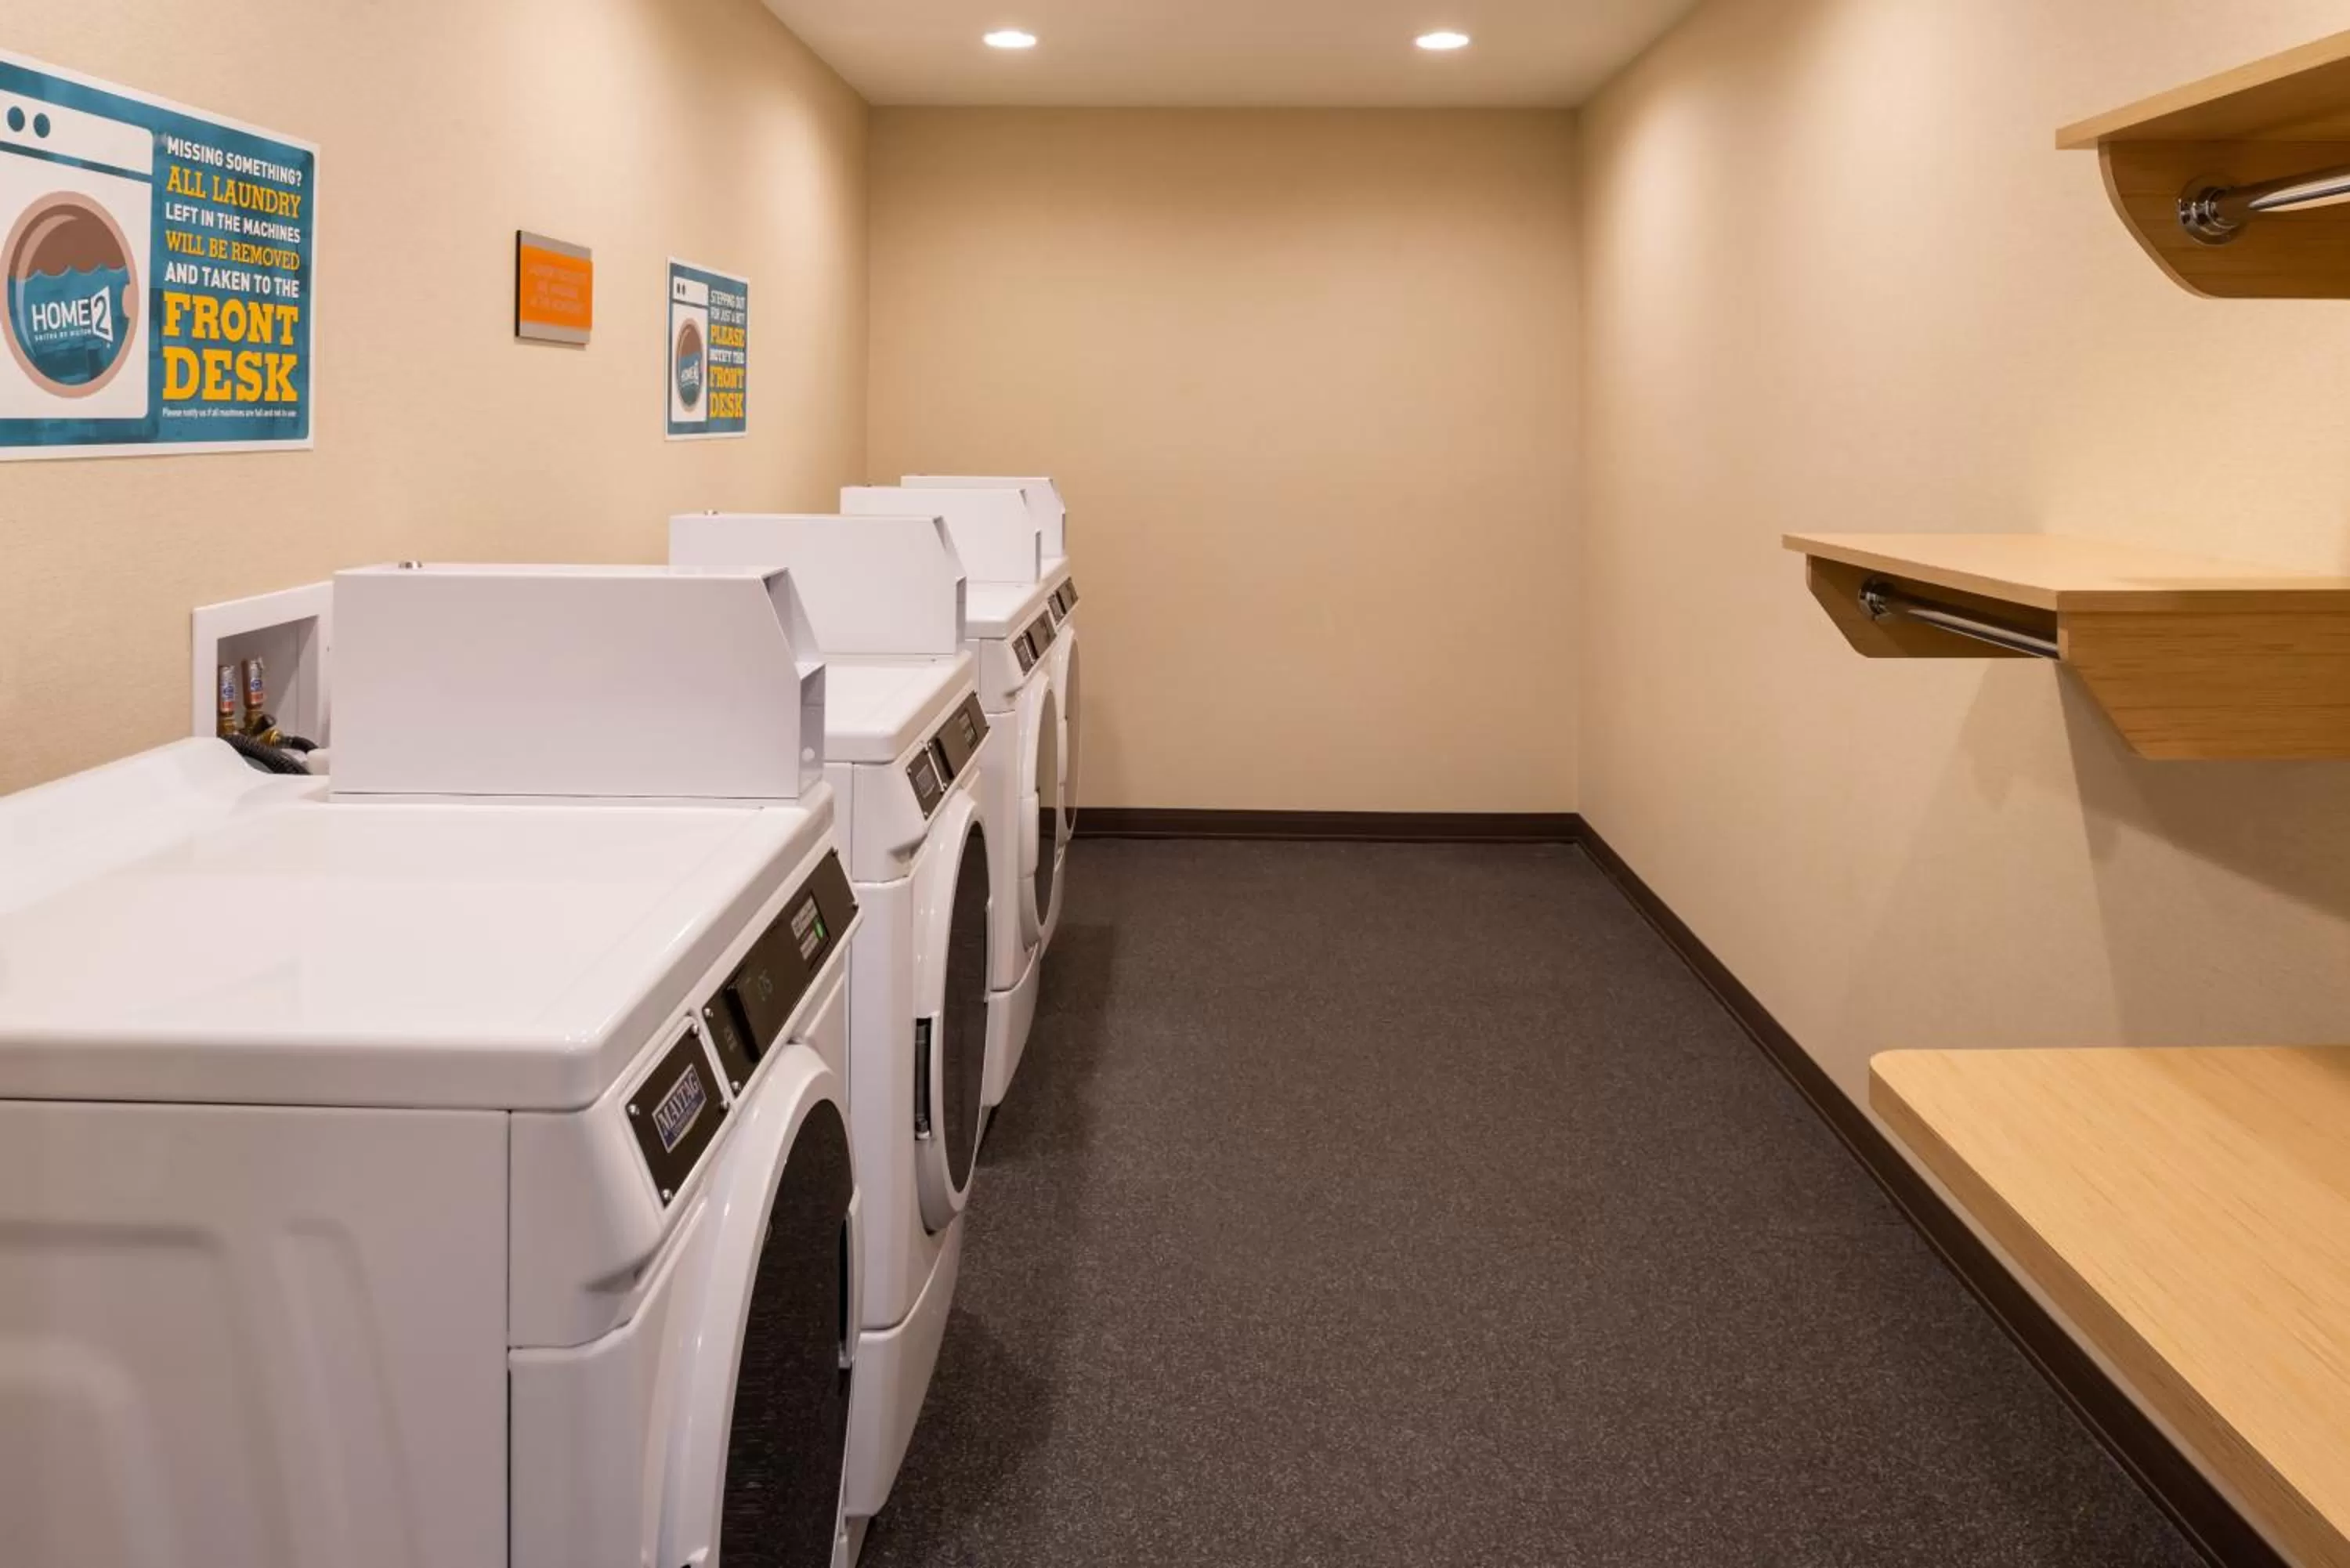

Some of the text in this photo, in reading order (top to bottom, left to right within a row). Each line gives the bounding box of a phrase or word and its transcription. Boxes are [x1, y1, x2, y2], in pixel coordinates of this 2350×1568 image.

[167, 135, 302, 187] MISSING SOMETHING?
[166, 165, 302, 219] ALL LAUNDRY
[165, 202, 301, 244] LEFT IN THE MACHINES
[165, 229, 300, 270] WILL BE REMOVED
[164, 261, 300, 298] AND TAKEN TO THE
[163, 291, 299, 345] FRONT
[710, 325, 745, 349] PLEASE
[162, 345, 298, 402] DESK
[710, 366, 744, 389] FRONT
[710, 392, 744, 417] DESK
[657, 1072, 699, 1137] MAYTAG
